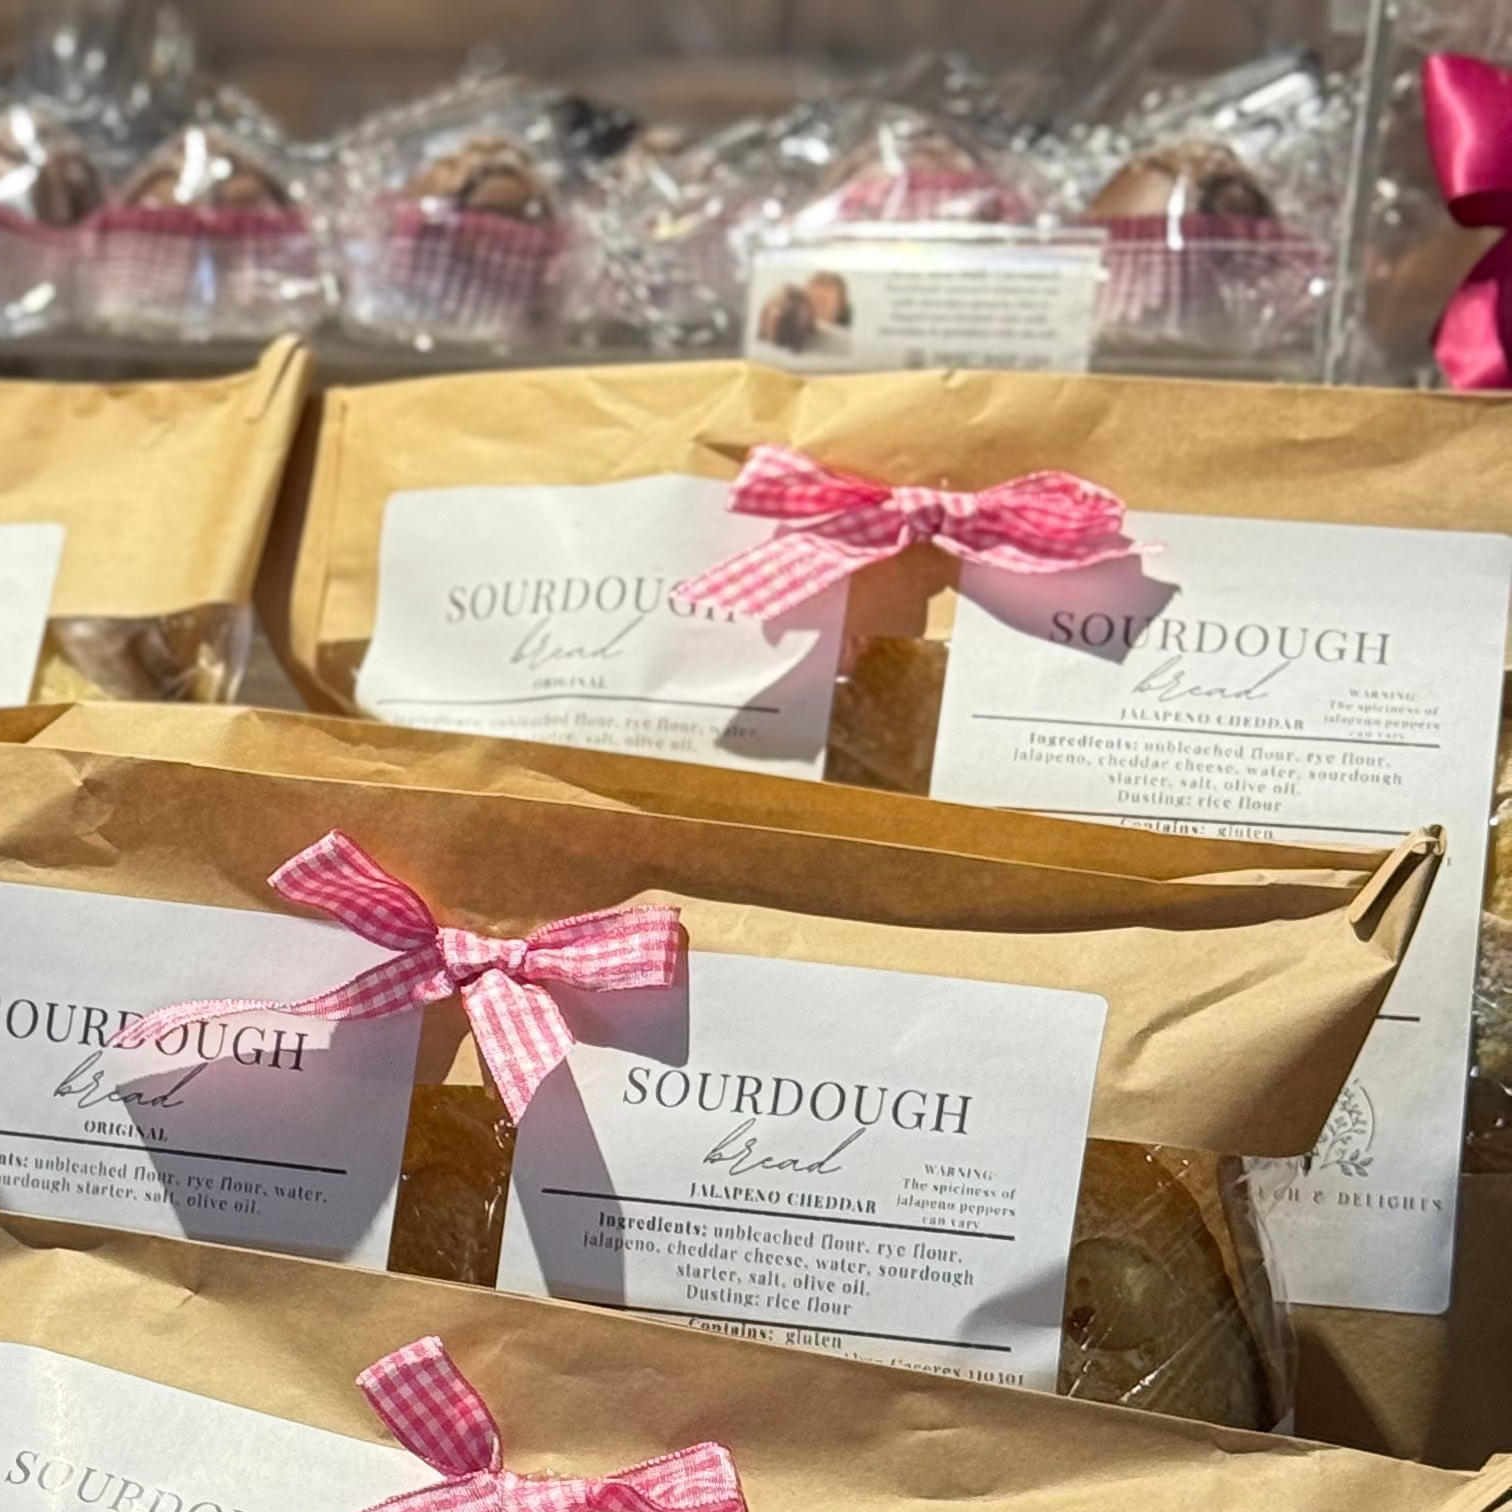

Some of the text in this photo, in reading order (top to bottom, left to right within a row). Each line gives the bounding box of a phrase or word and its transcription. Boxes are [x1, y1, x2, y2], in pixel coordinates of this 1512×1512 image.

[445, 574, 737, 624] SOURDOUG
[53, 1050, 208, 1110] bread
[622, 1065, 973, 1135] SOURDOUGH
[83, 1119, 167, 1141] ORIGINAL
[702, 1117, 866, 1176] bread
[33, 1155, 128, 1180] unbleached
[186, 1174, 214, 1197] rye
[902, 1176, 1016, 1200] The spiciness of
[186, 1192, 228, 1211] olive
[689, 1181, 876, 1214] JALAPENO CHEDDAR
[895, 1193, 1015, 1217] jalapeno peppers
[713, 1224, 815, 1251] unbleached
[877, 1242, 906, 1259] rye
[666, 1238, 738, 1261] cheddar
[878, 1263, 974, 1287] sourdough
[791, 1272, 836, 1294] olive
[765, 1291, 800, 1311] rice
[805, 1295, 851, 1316] flour
[784, 1330, 843, 1350] gluten
[967, 1368, 1025, 1387] 110301
